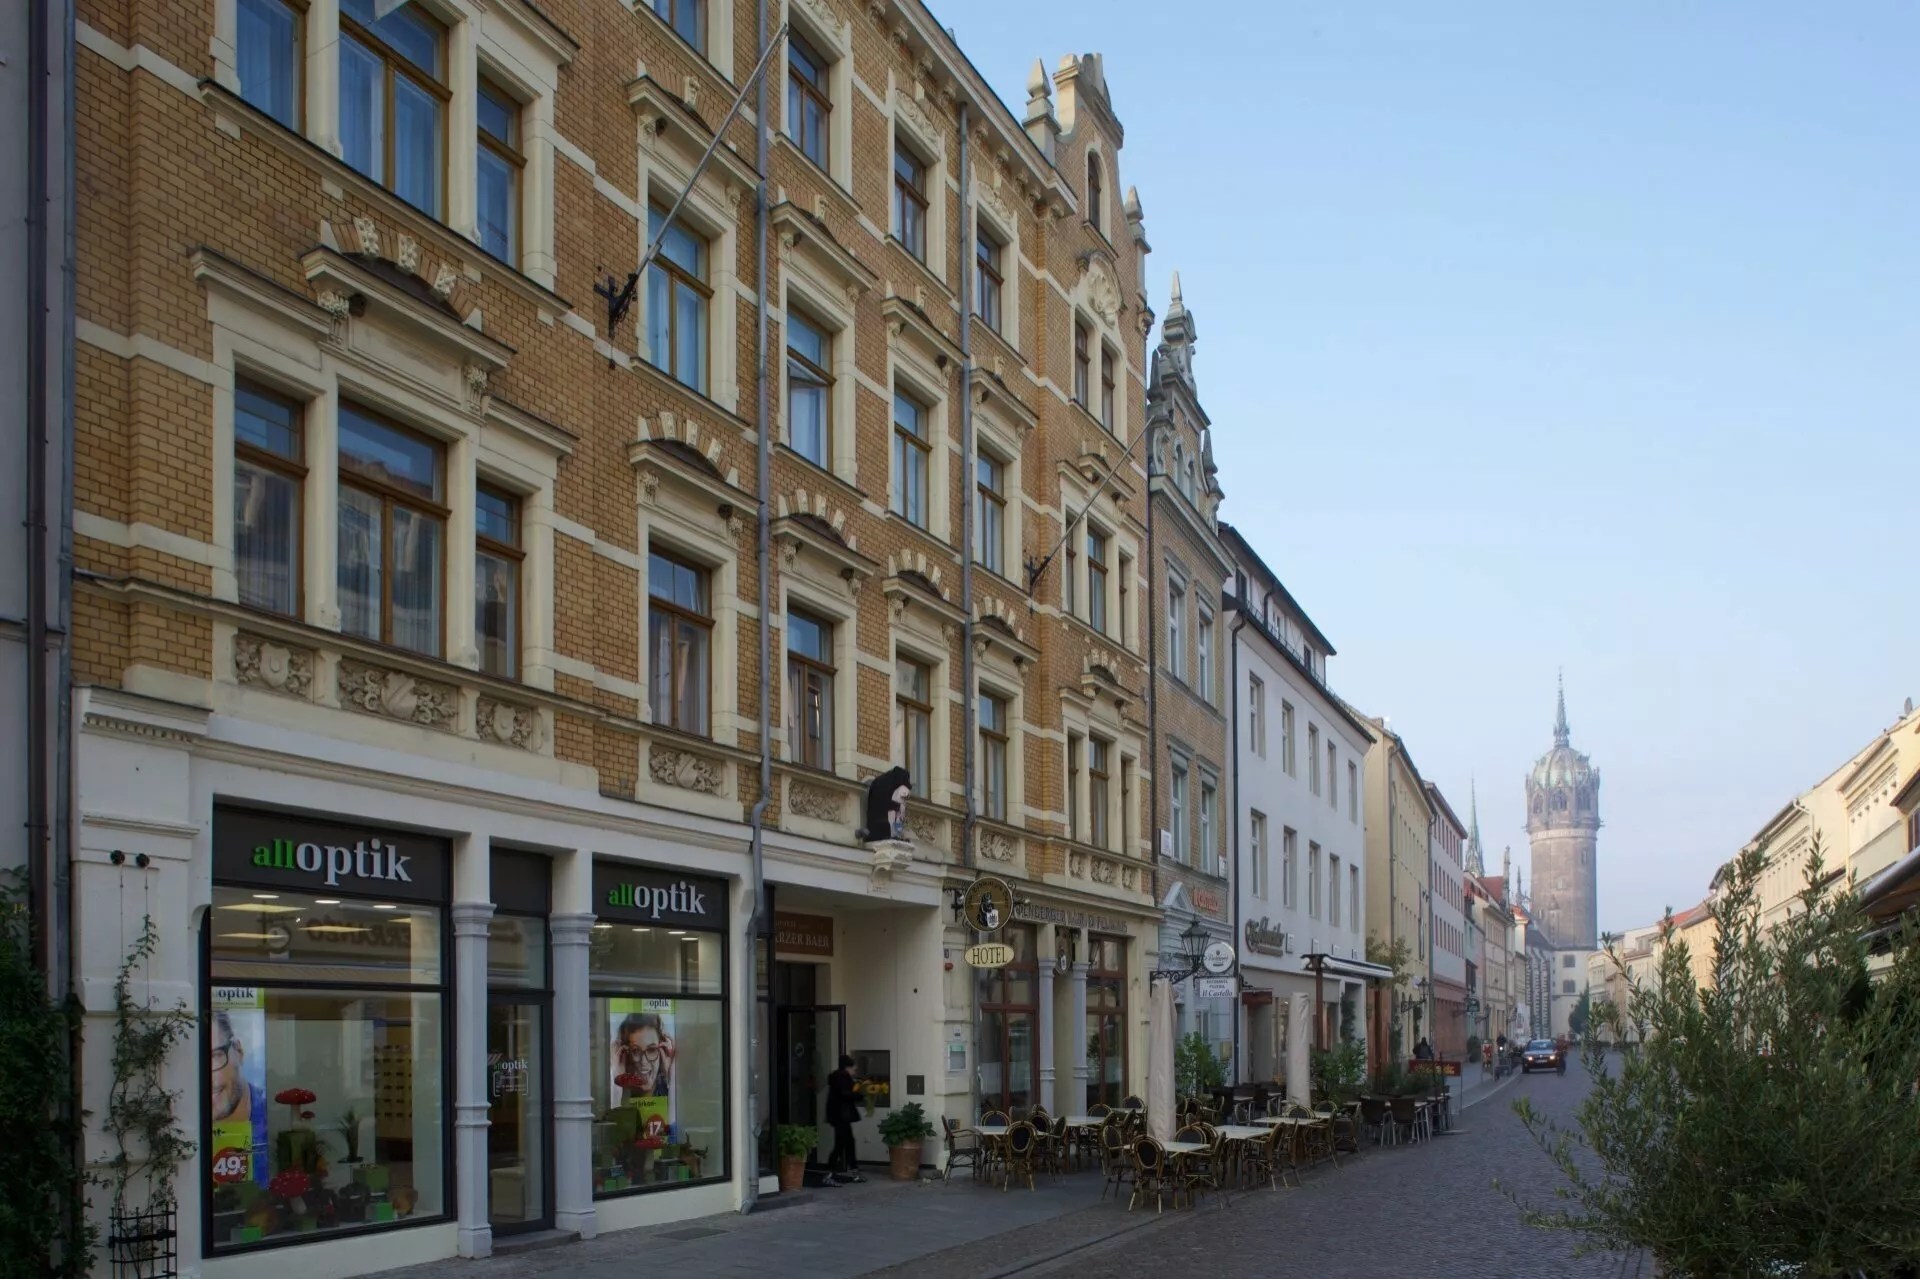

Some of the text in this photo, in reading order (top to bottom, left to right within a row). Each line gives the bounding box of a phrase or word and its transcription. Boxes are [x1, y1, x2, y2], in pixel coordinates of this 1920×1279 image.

[253, 838, 413, 886] alloptik
[608, 881, 706, 919] alloptik
[972, 946, 1008, 965] HOTEL
[213, 1156, 241, 1176] 49
